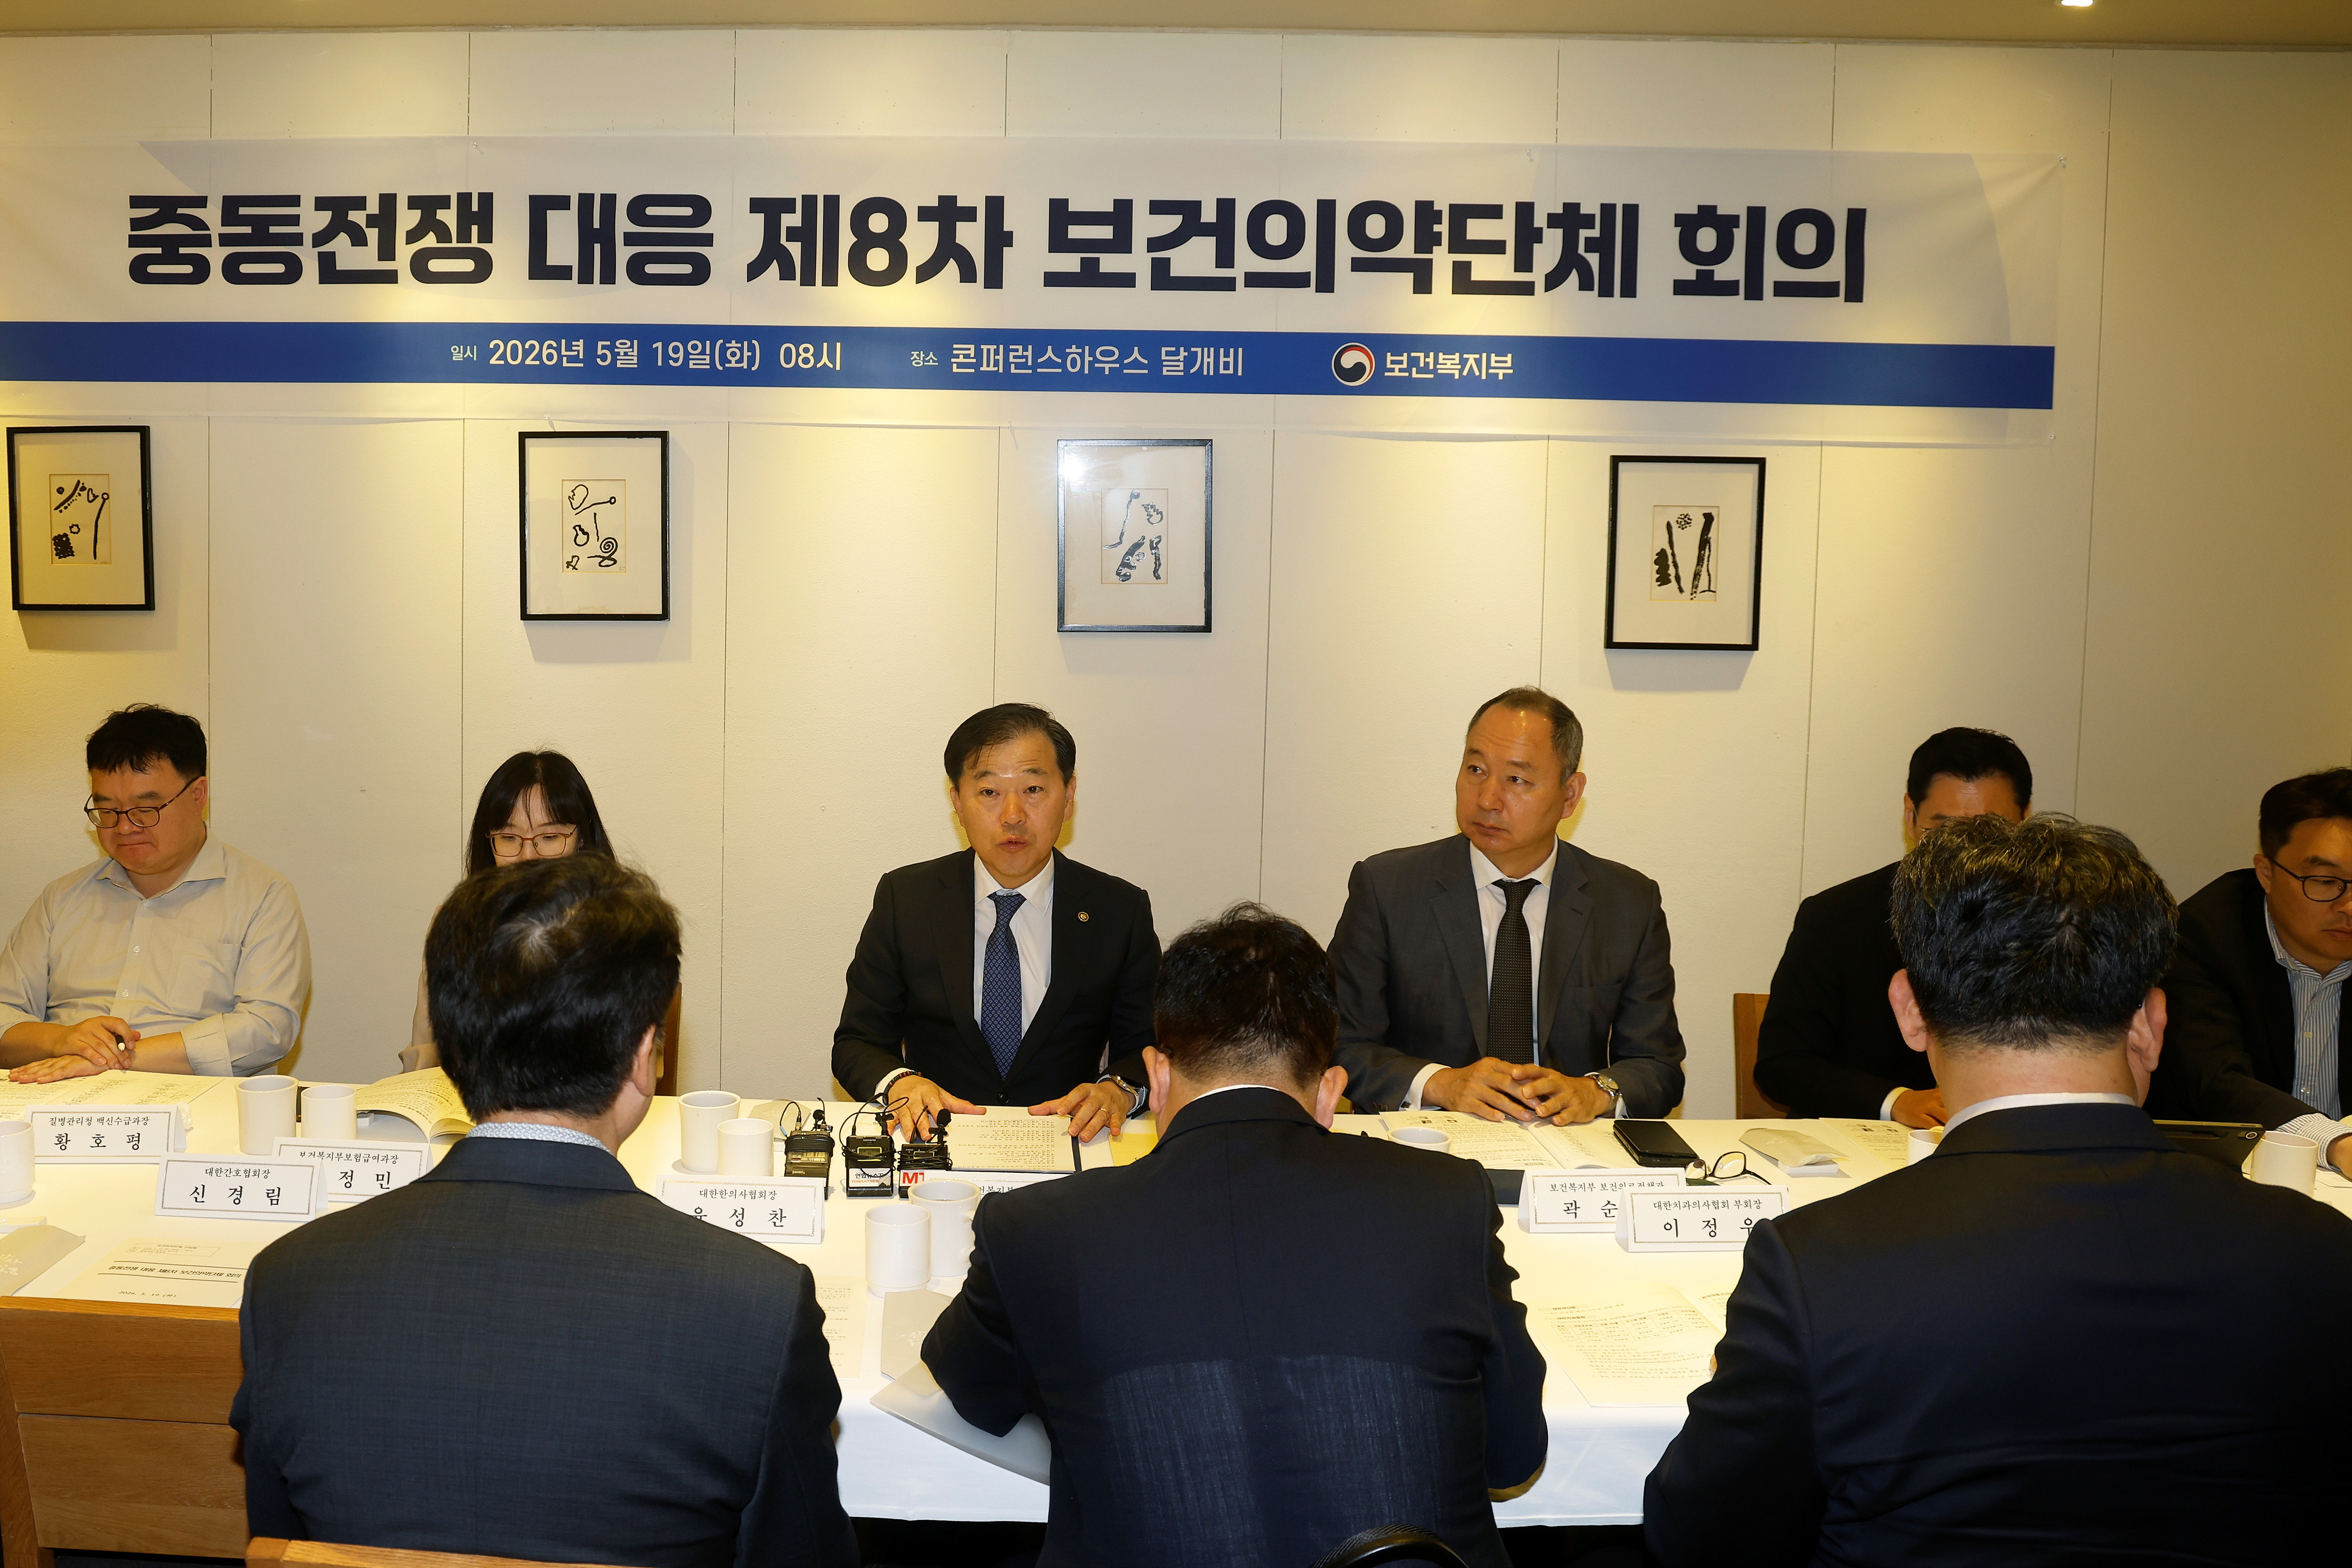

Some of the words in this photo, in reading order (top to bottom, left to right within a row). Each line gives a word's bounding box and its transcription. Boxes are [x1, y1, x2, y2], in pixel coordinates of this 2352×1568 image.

[128, 192, 493, 285] 중동전쟁
[528, 193, 714, 286] 대응
[747, 195, 1013, 289] 제8차
[1043, 198, 1639, 298] 보건의약단체
[1673, 204, 1867, 303] 회의
[451, 345, 477, 361] 일시
[489, 339, 584, 367] 2026년
[596, 339, 637, 367] 5월
[652, 339, 760, 371] 19일(화)
[780, 342, 841, 370] 08시
[910, 350, 938, 367] 장소
[951, 344, 1148, 374] 콘퍼런스하우스
[1161, 347, 1242, 376] 달개비
[1384, 351, 1513, 380] 보건복지부
[49, 1116, 92, 1126] 질병관리청
[97, 1116, 150, 1126] 백신수급과장
[205, 1167, 271, 1179] 대한간호협회장
[1550, 1183, 1596, 1192] 보건복지부
[699, 1188, 777, 1201] 대한한의사협회장
[1653, 1200, 1729, 1210] 대한치과의사협회
[1734, 1199, 1762, 1210] 부회장
